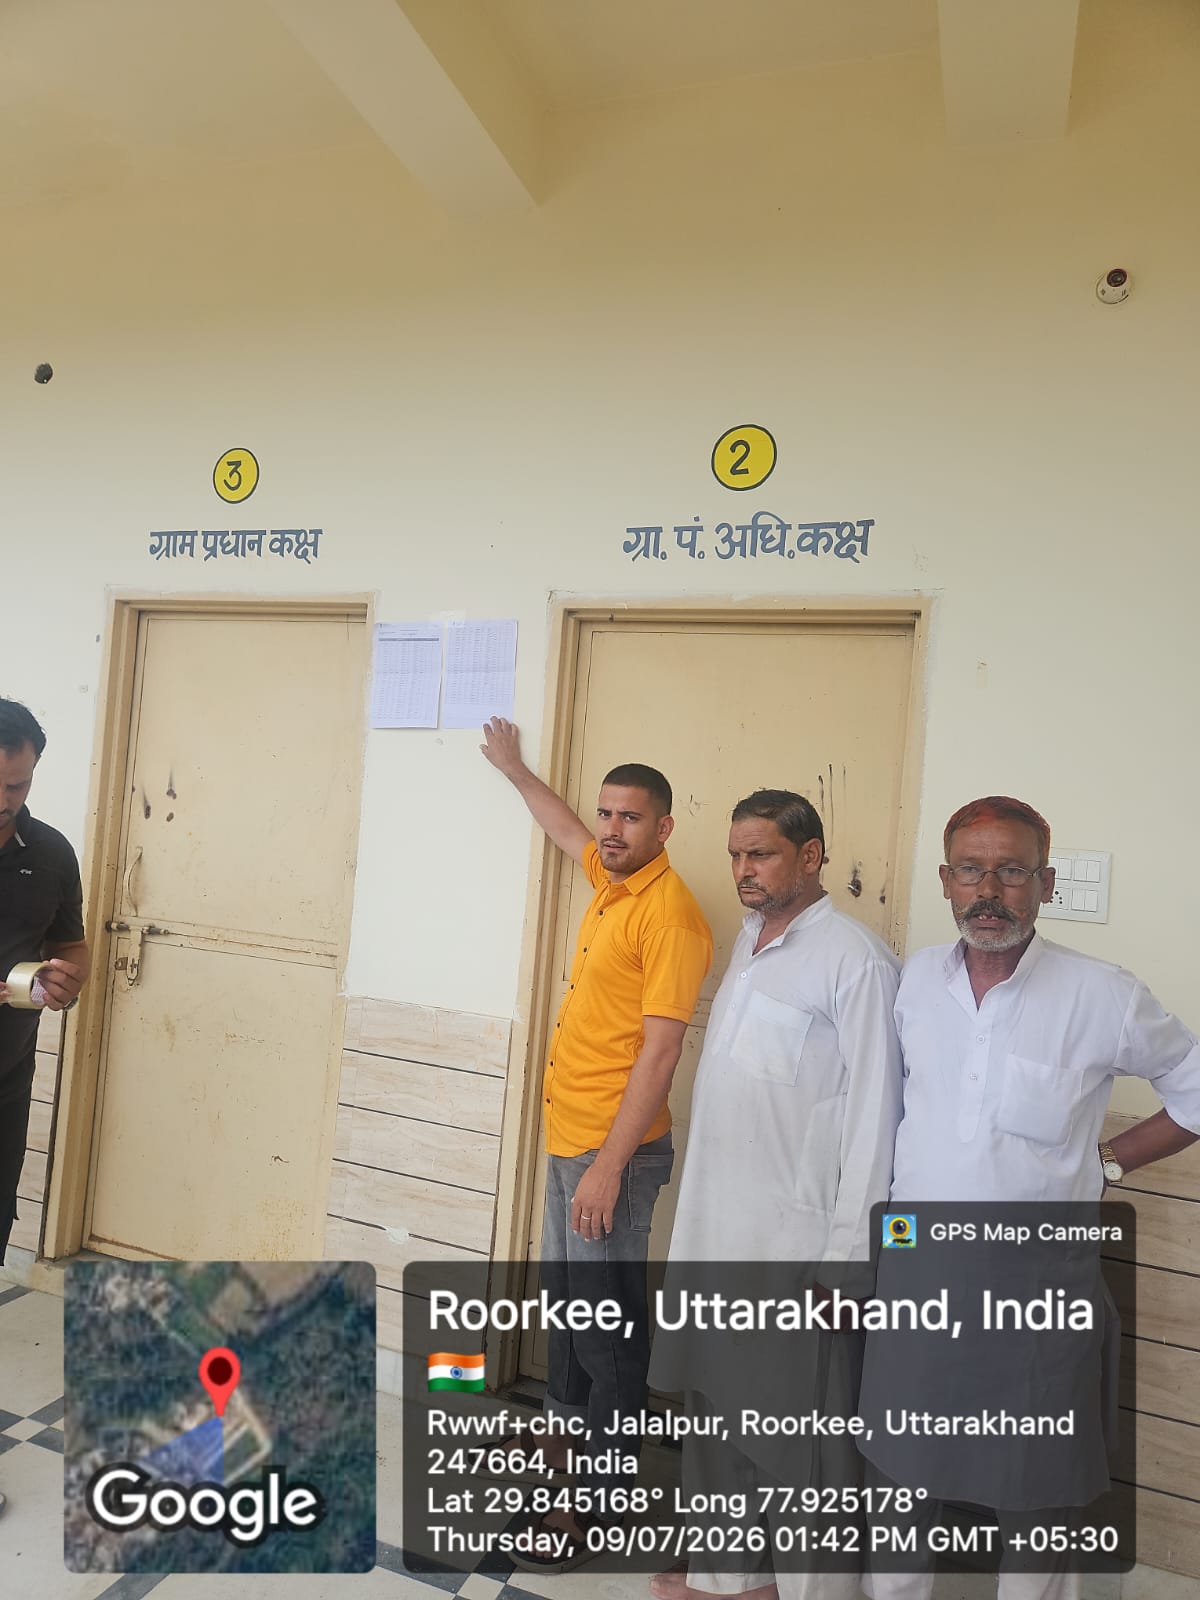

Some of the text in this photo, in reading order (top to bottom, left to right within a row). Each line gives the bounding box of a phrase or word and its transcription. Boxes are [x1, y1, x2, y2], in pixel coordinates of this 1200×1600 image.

[223, 460, 242, 492] 3
[729, 439, 751, 476] 2
[149, 528, 324, 565] ग्राम प्रधान कक्ष
[622, 526, 668, 562] ग्रा.
[673, 515, 706, 560] पं.
